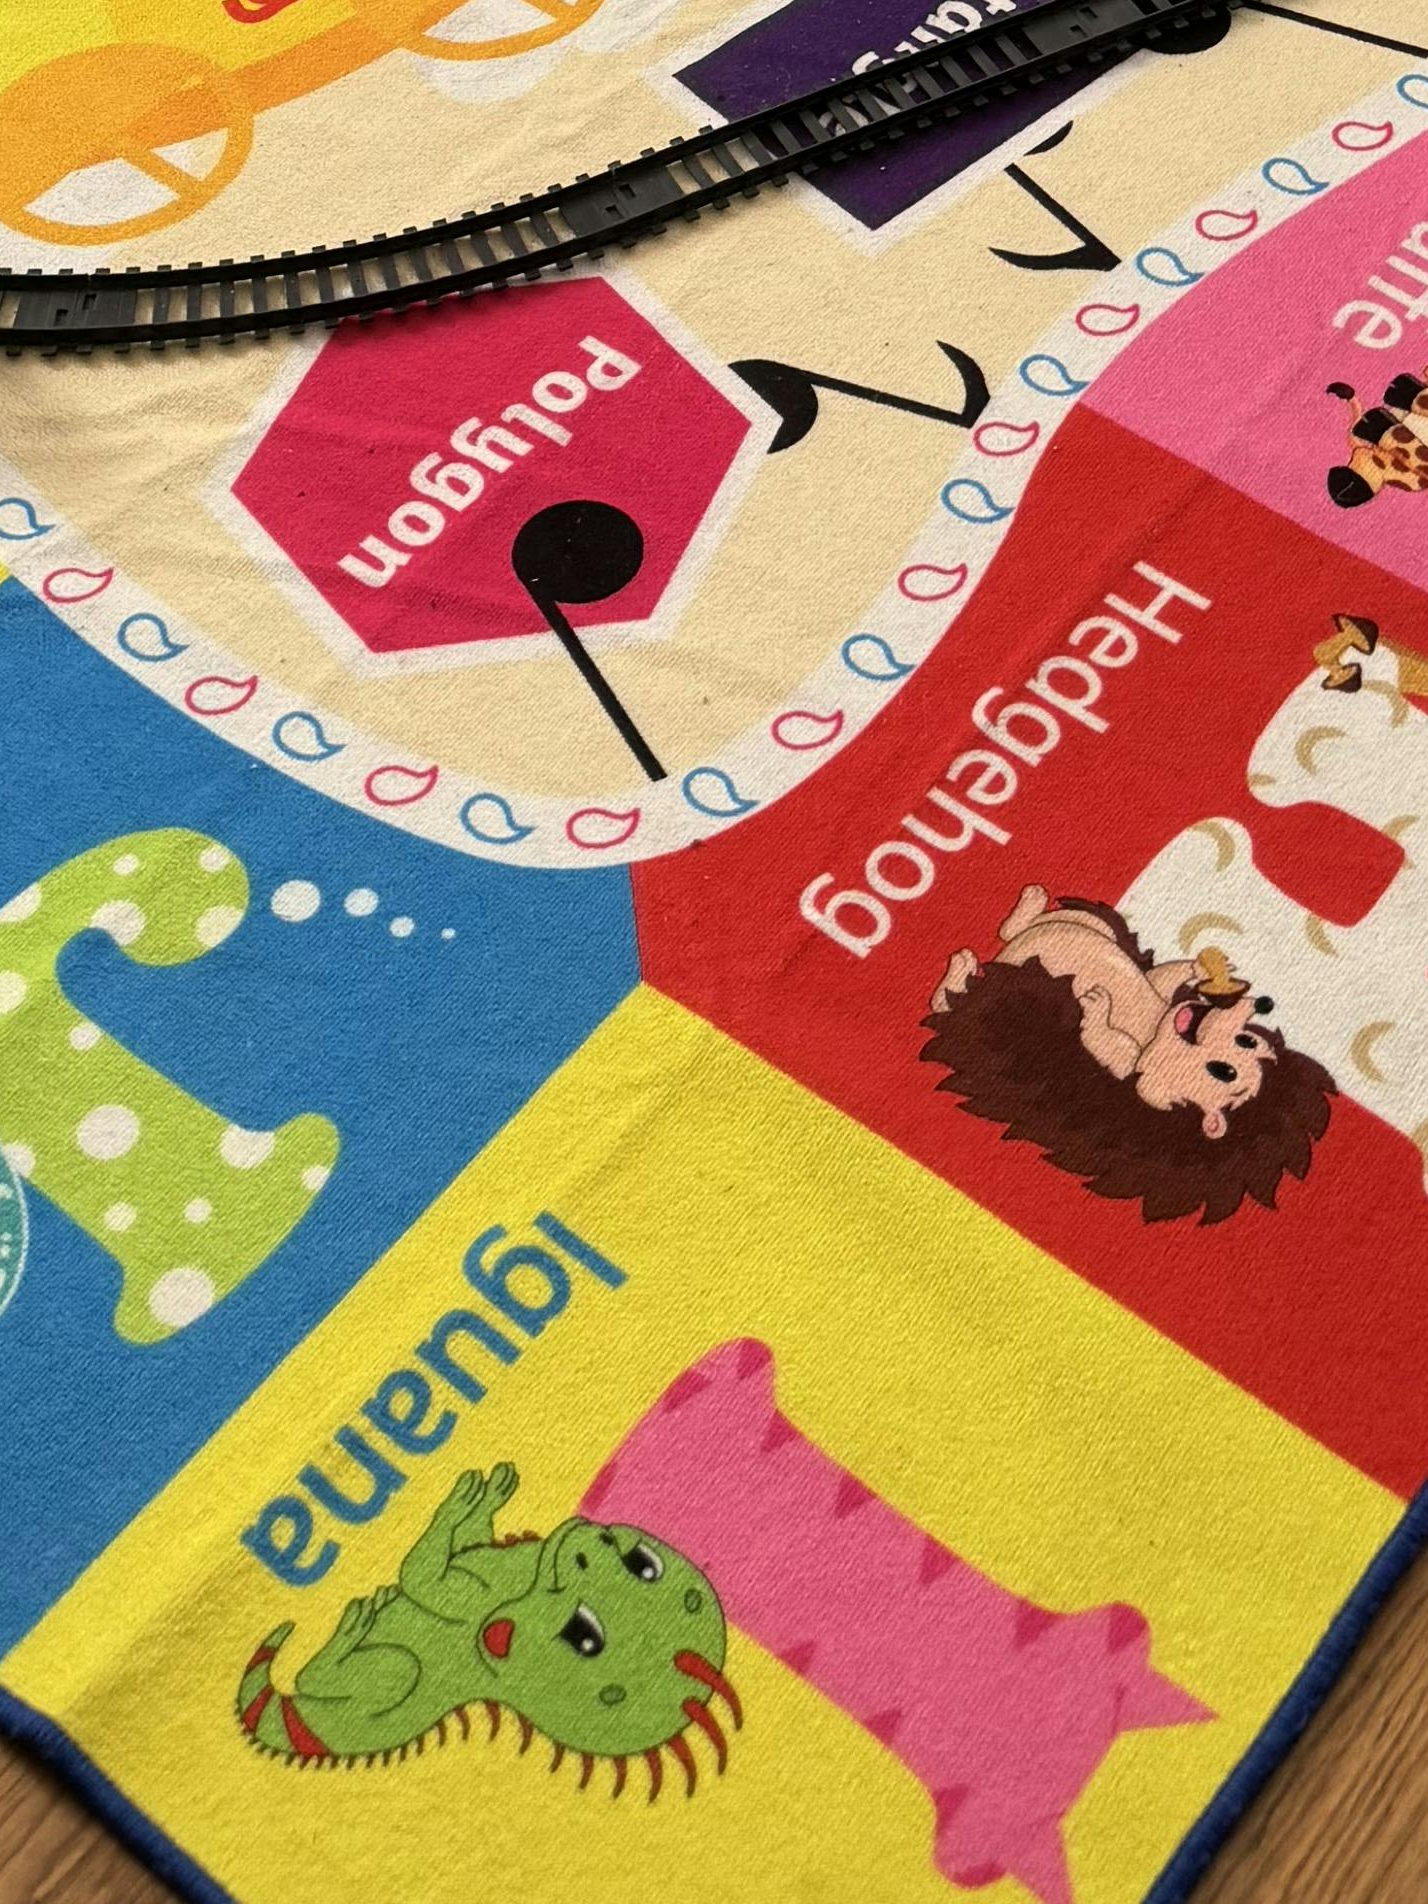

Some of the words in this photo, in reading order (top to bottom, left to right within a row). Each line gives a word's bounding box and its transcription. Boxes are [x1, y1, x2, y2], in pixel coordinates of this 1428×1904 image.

[336, 337, 642, 590] Polygon
[799, 559, 1212, 960] Hedgehog
[239, 1209, 630, 1589] Iguana
